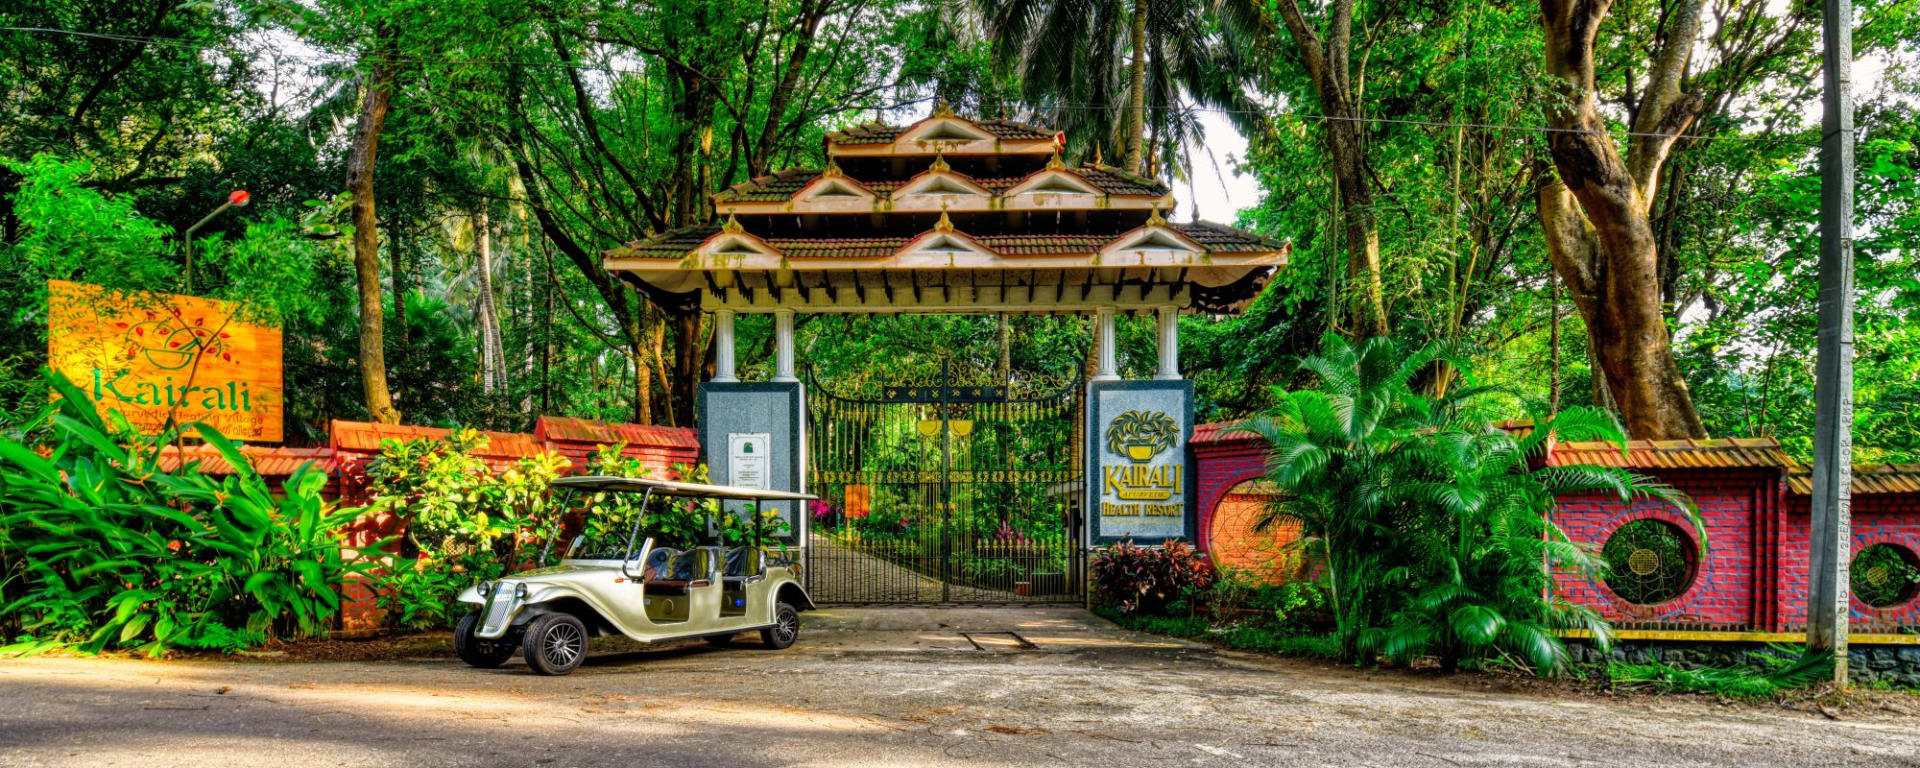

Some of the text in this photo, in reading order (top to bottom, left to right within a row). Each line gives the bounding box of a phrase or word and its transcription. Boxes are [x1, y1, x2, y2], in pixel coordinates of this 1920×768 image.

[93, 368, 252, 412] Kairali
[222, 411, 264, 426] Village
[1103, 463, 1183, 495] KAIRALI
[1102, 502, 1183, 516] HEALTH RESORT
